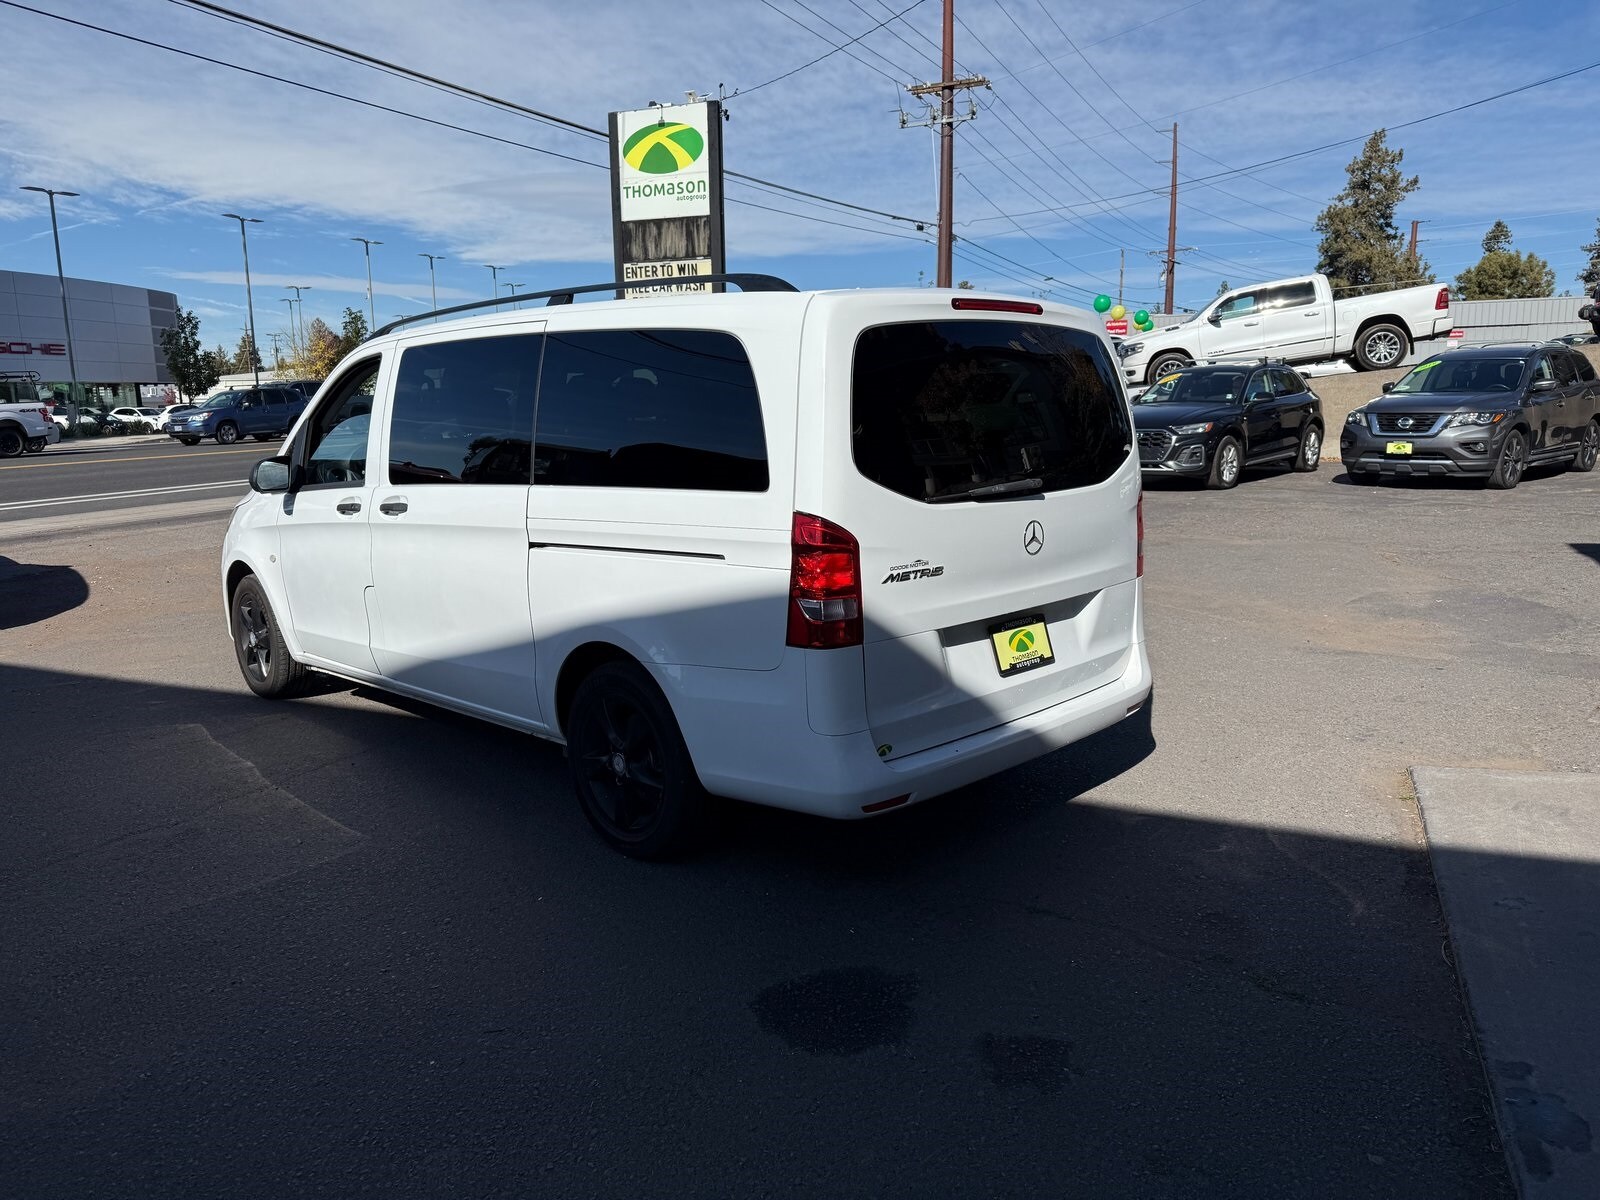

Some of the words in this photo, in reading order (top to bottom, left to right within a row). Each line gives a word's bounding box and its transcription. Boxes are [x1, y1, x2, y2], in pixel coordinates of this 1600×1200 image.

[676, 193, 707, 201] autogroup
[625, 265, 659, 279] ENTER
[660, 264, 673, 277] TO
[677, 263, 698, 276] WIN
[652, 284, 673, 293] CAR
[676, 282, 706, 292] WASH
[881, 565, 945, 585] METRIS
[1016, 657, 1040, 668] autogroup
